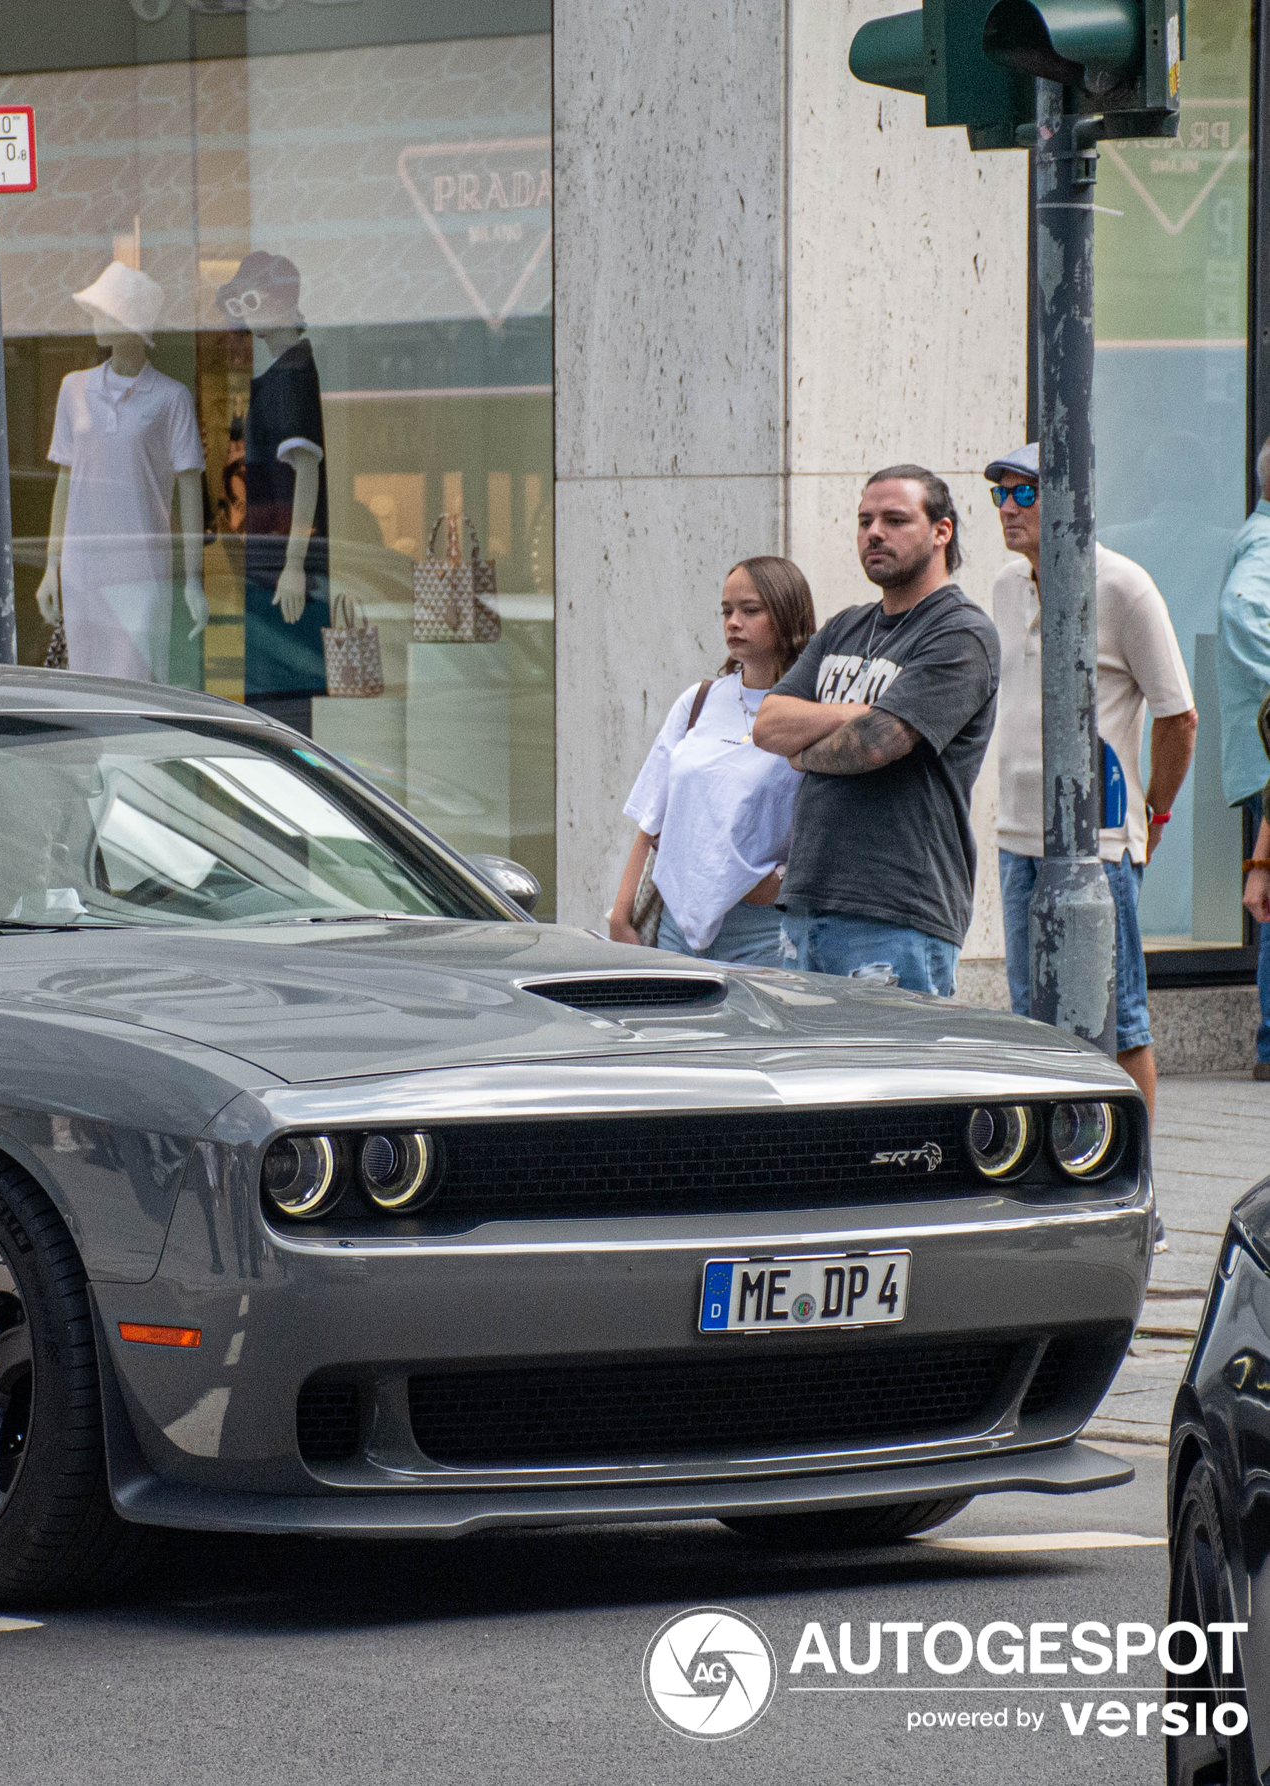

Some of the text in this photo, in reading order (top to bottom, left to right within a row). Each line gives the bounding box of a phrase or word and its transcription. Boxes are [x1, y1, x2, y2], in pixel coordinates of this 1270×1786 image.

[870, 1149, 928, 1167] SRT
[738, 1262, 898, 1322] ME DP 4
[711, 1303, 722, 1318] D
